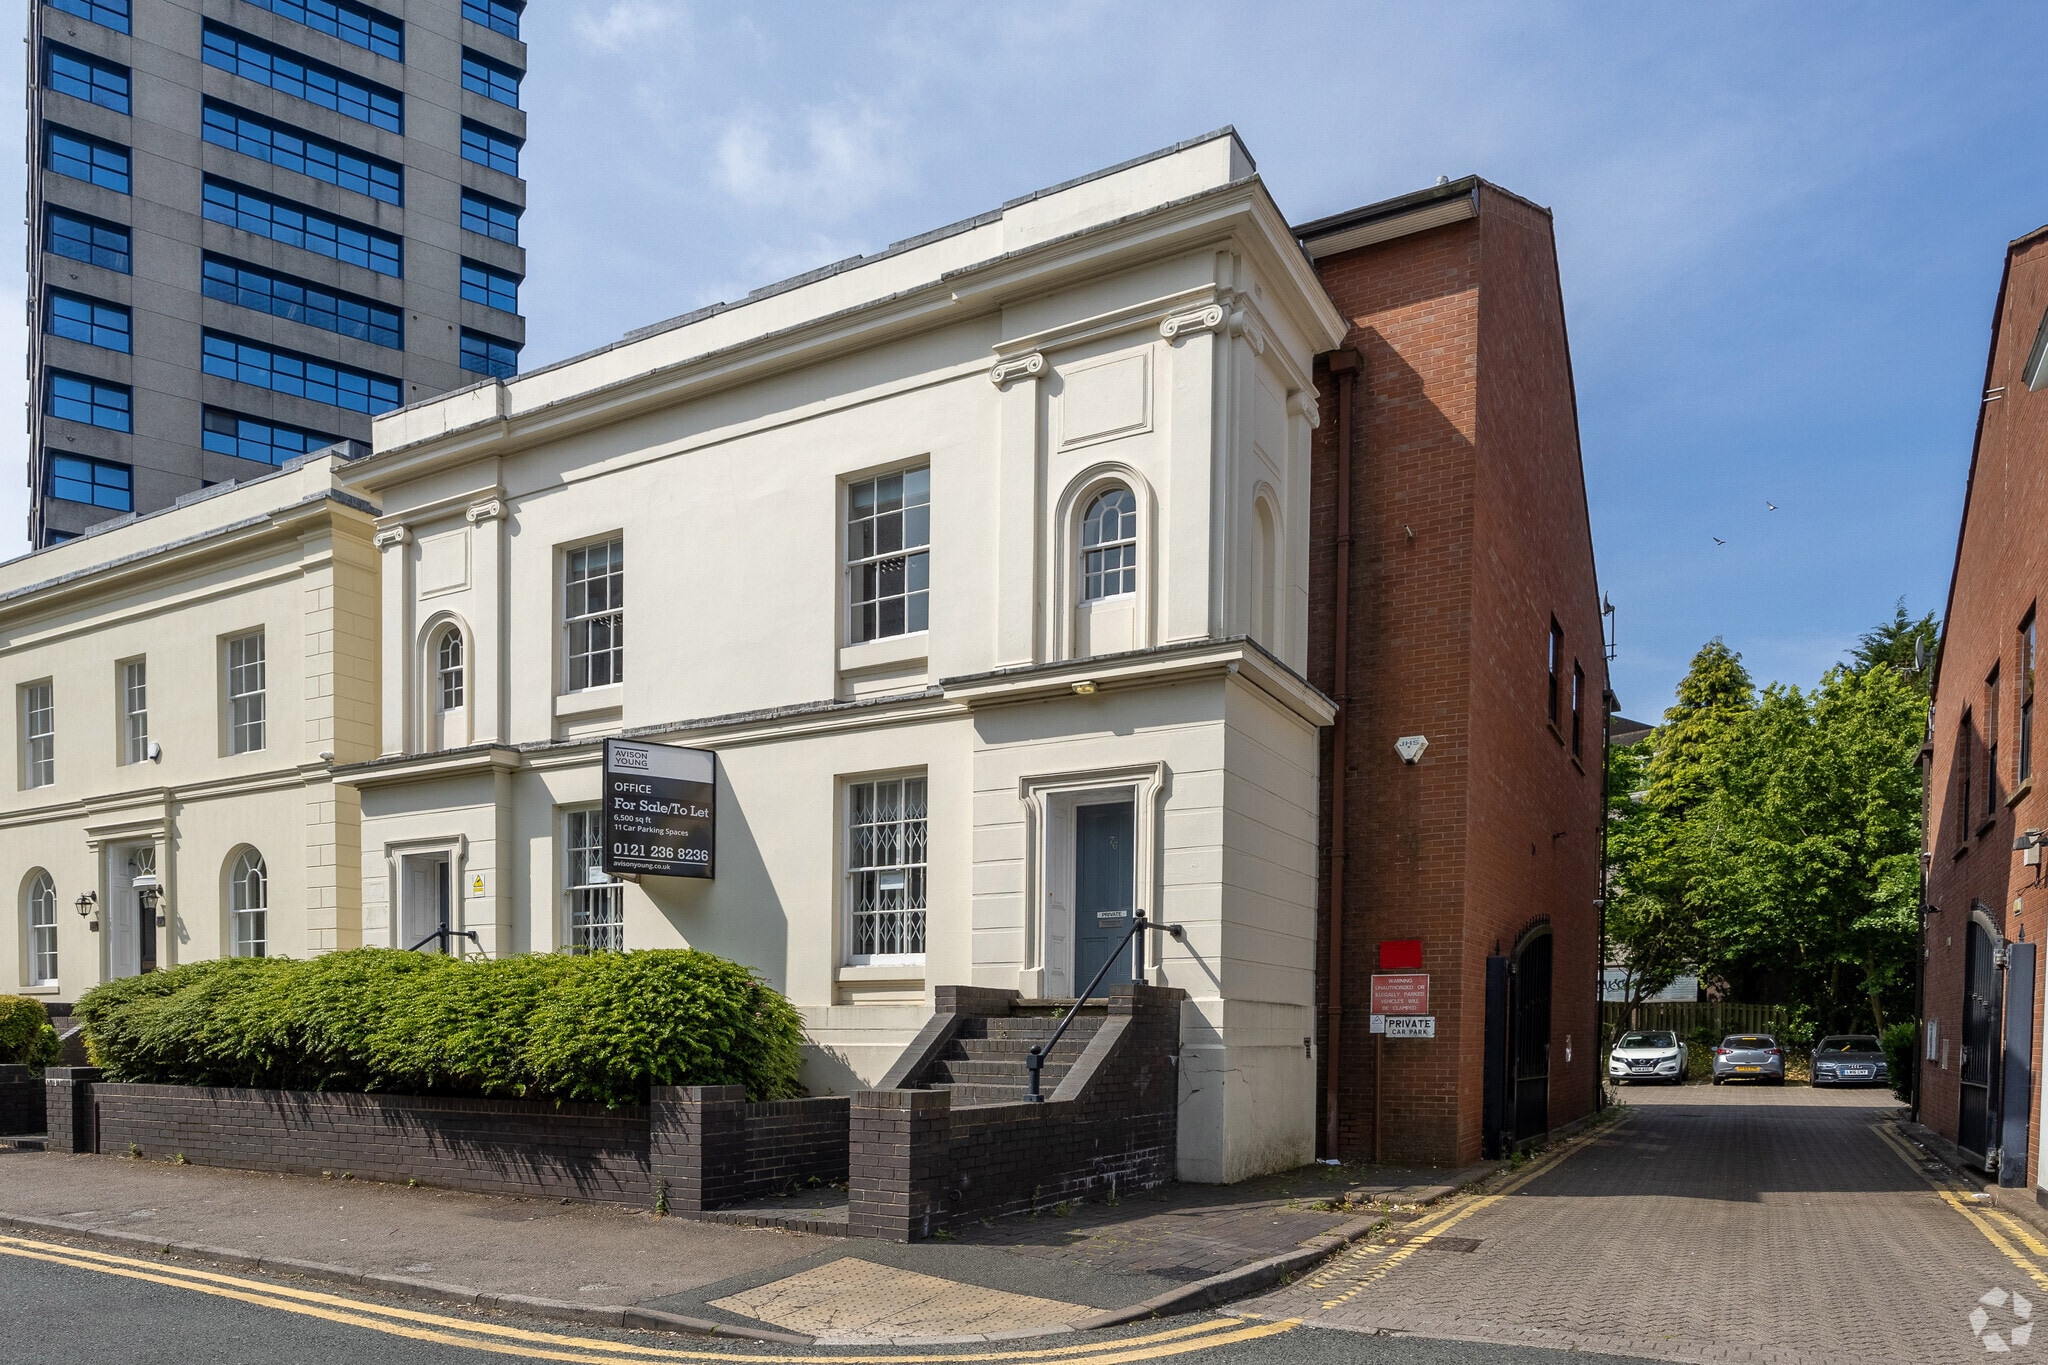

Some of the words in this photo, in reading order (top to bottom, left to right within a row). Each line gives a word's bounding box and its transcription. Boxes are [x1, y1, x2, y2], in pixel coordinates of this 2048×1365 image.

[615, 750, 648, 759] AVISON
[615, 758, 648, 767] YOUNG
[614, 782, 652, 794] OFFICE
[614, 797, 637, 810] For
[639, 799, 688, 815] Sale/To
[690, 805, 709, 818] Let
[613, 814, 634, 822] 6,500
[645, 816, 651, 824] ft
[623, 824, 636, 832] Car
[637, 825, 664, 835] Parking
[665, 828, 689, 837] Spaces
[613, 842, 646, 856] 0121
[650, 845, 674, 859] 236
[677, 847, 709, 861] 8236
[613, 860, 671, 870] avisonyoung.co.uk
[1388, 1019, 1431, 1028] PRIVATE
